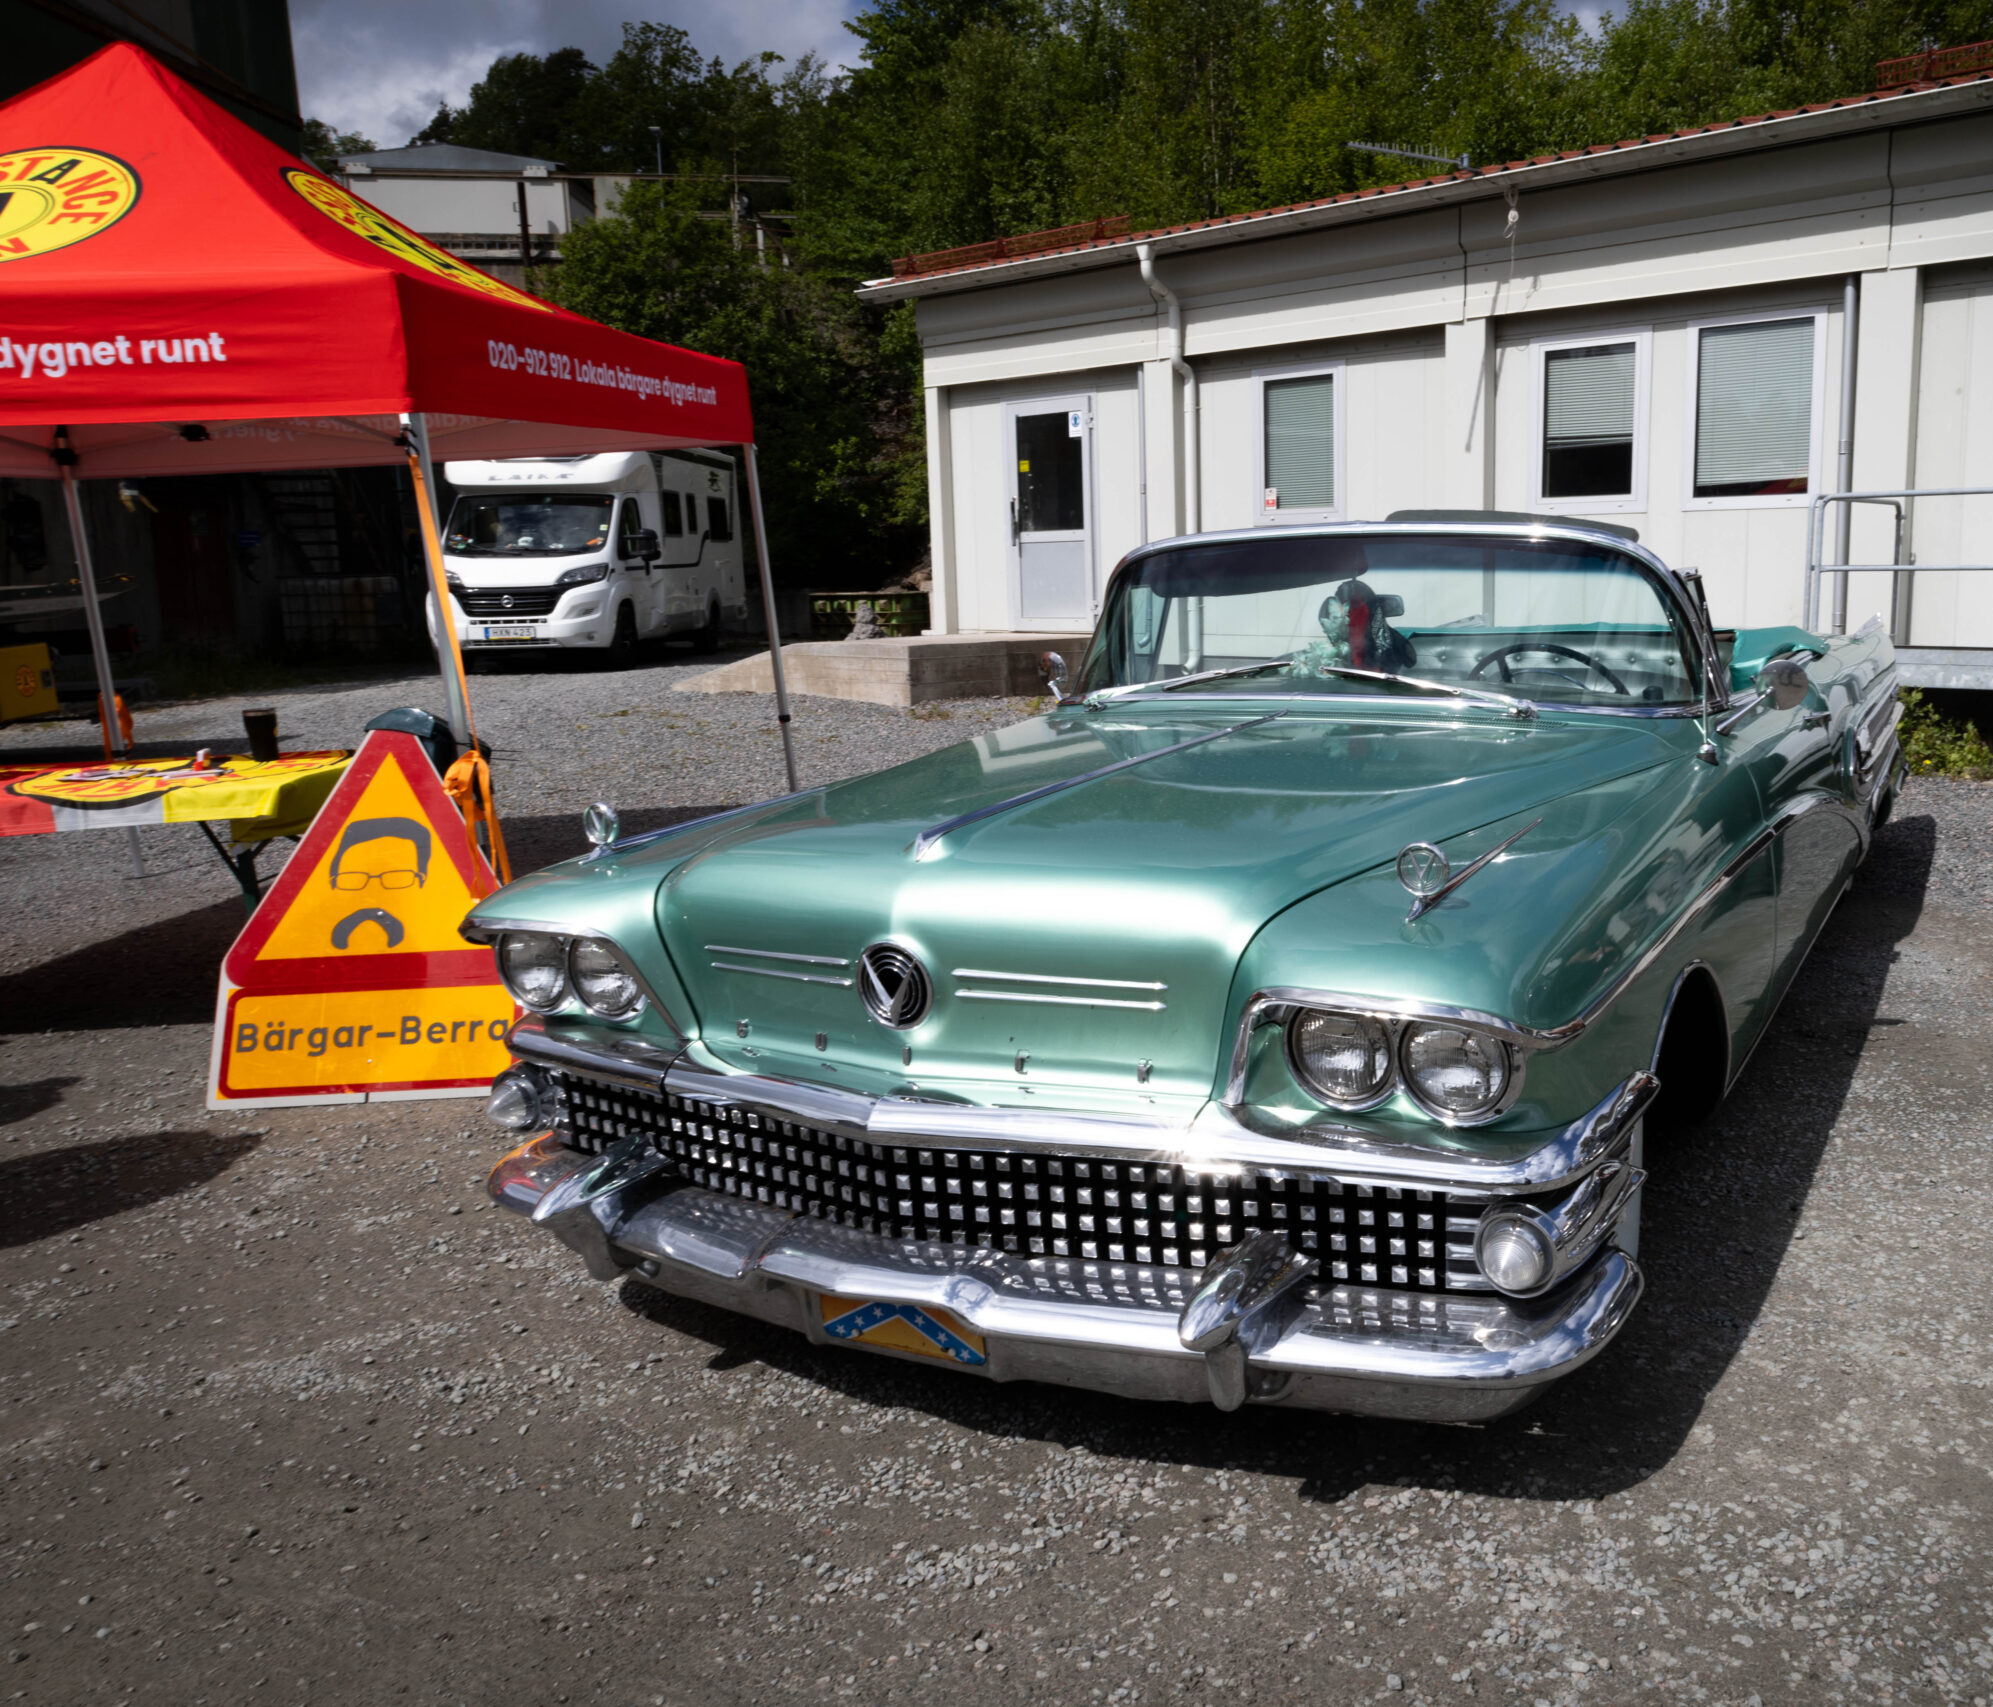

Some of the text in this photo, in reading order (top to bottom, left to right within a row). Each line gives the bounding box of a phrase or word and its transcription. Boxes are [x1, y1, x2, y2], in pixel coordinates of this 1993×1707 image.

[140, 332, 227, 364] runt
[488, 339, 717, 406] 020-912 912 Lokala bärgare dygnet runt
[235, 1015, 510, 1057] Bärgar-Berra
